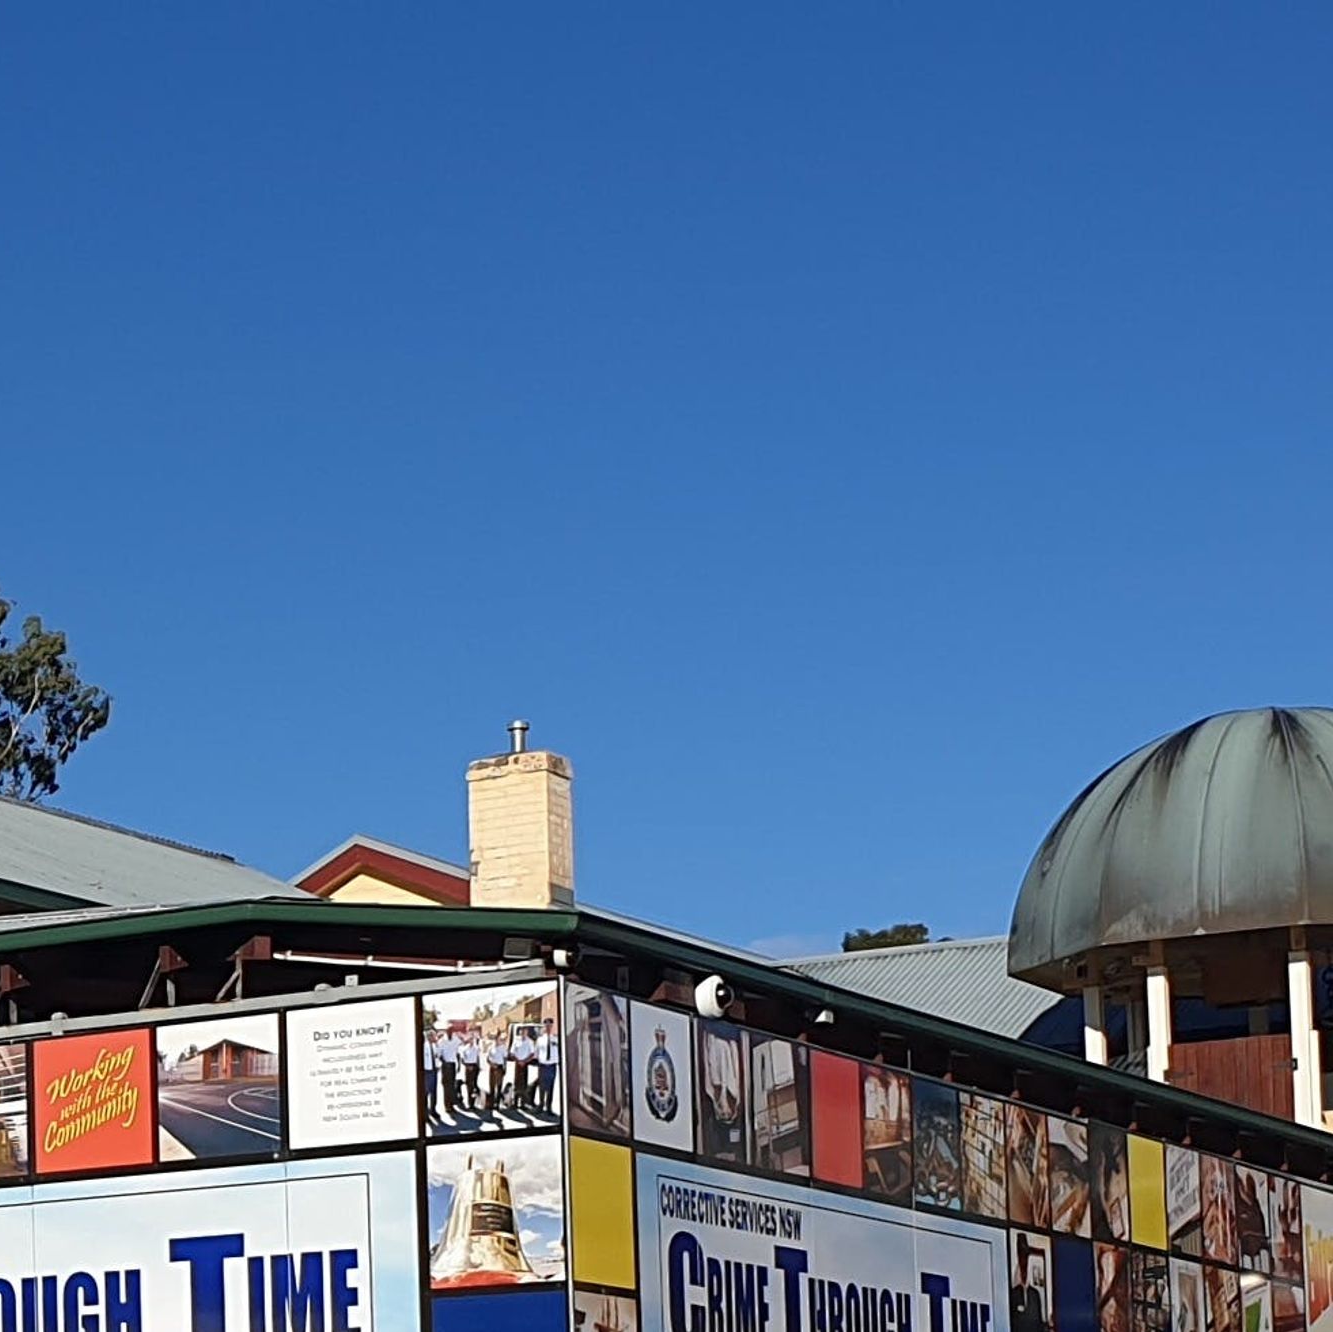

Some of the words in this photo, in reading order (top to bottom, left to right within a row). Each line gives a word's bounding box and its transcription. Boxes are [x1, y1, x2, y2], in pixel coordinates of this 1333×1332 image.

[333, 1029, 353, 1039] YOU
[355, 1023, 391, 1037] KNOW?
[46, 1045, 134, 1105] Working
[60, 1085, 92, 1121] with
[95, 1075, 118, 1104] the
[44, 1081, 138, 1153] Community
[660, 1183, 726, 1228] CORRECTIVE
[728, 1197, 778, 1237] SERVICES
[779, 1207, 802, 1241] NSW
